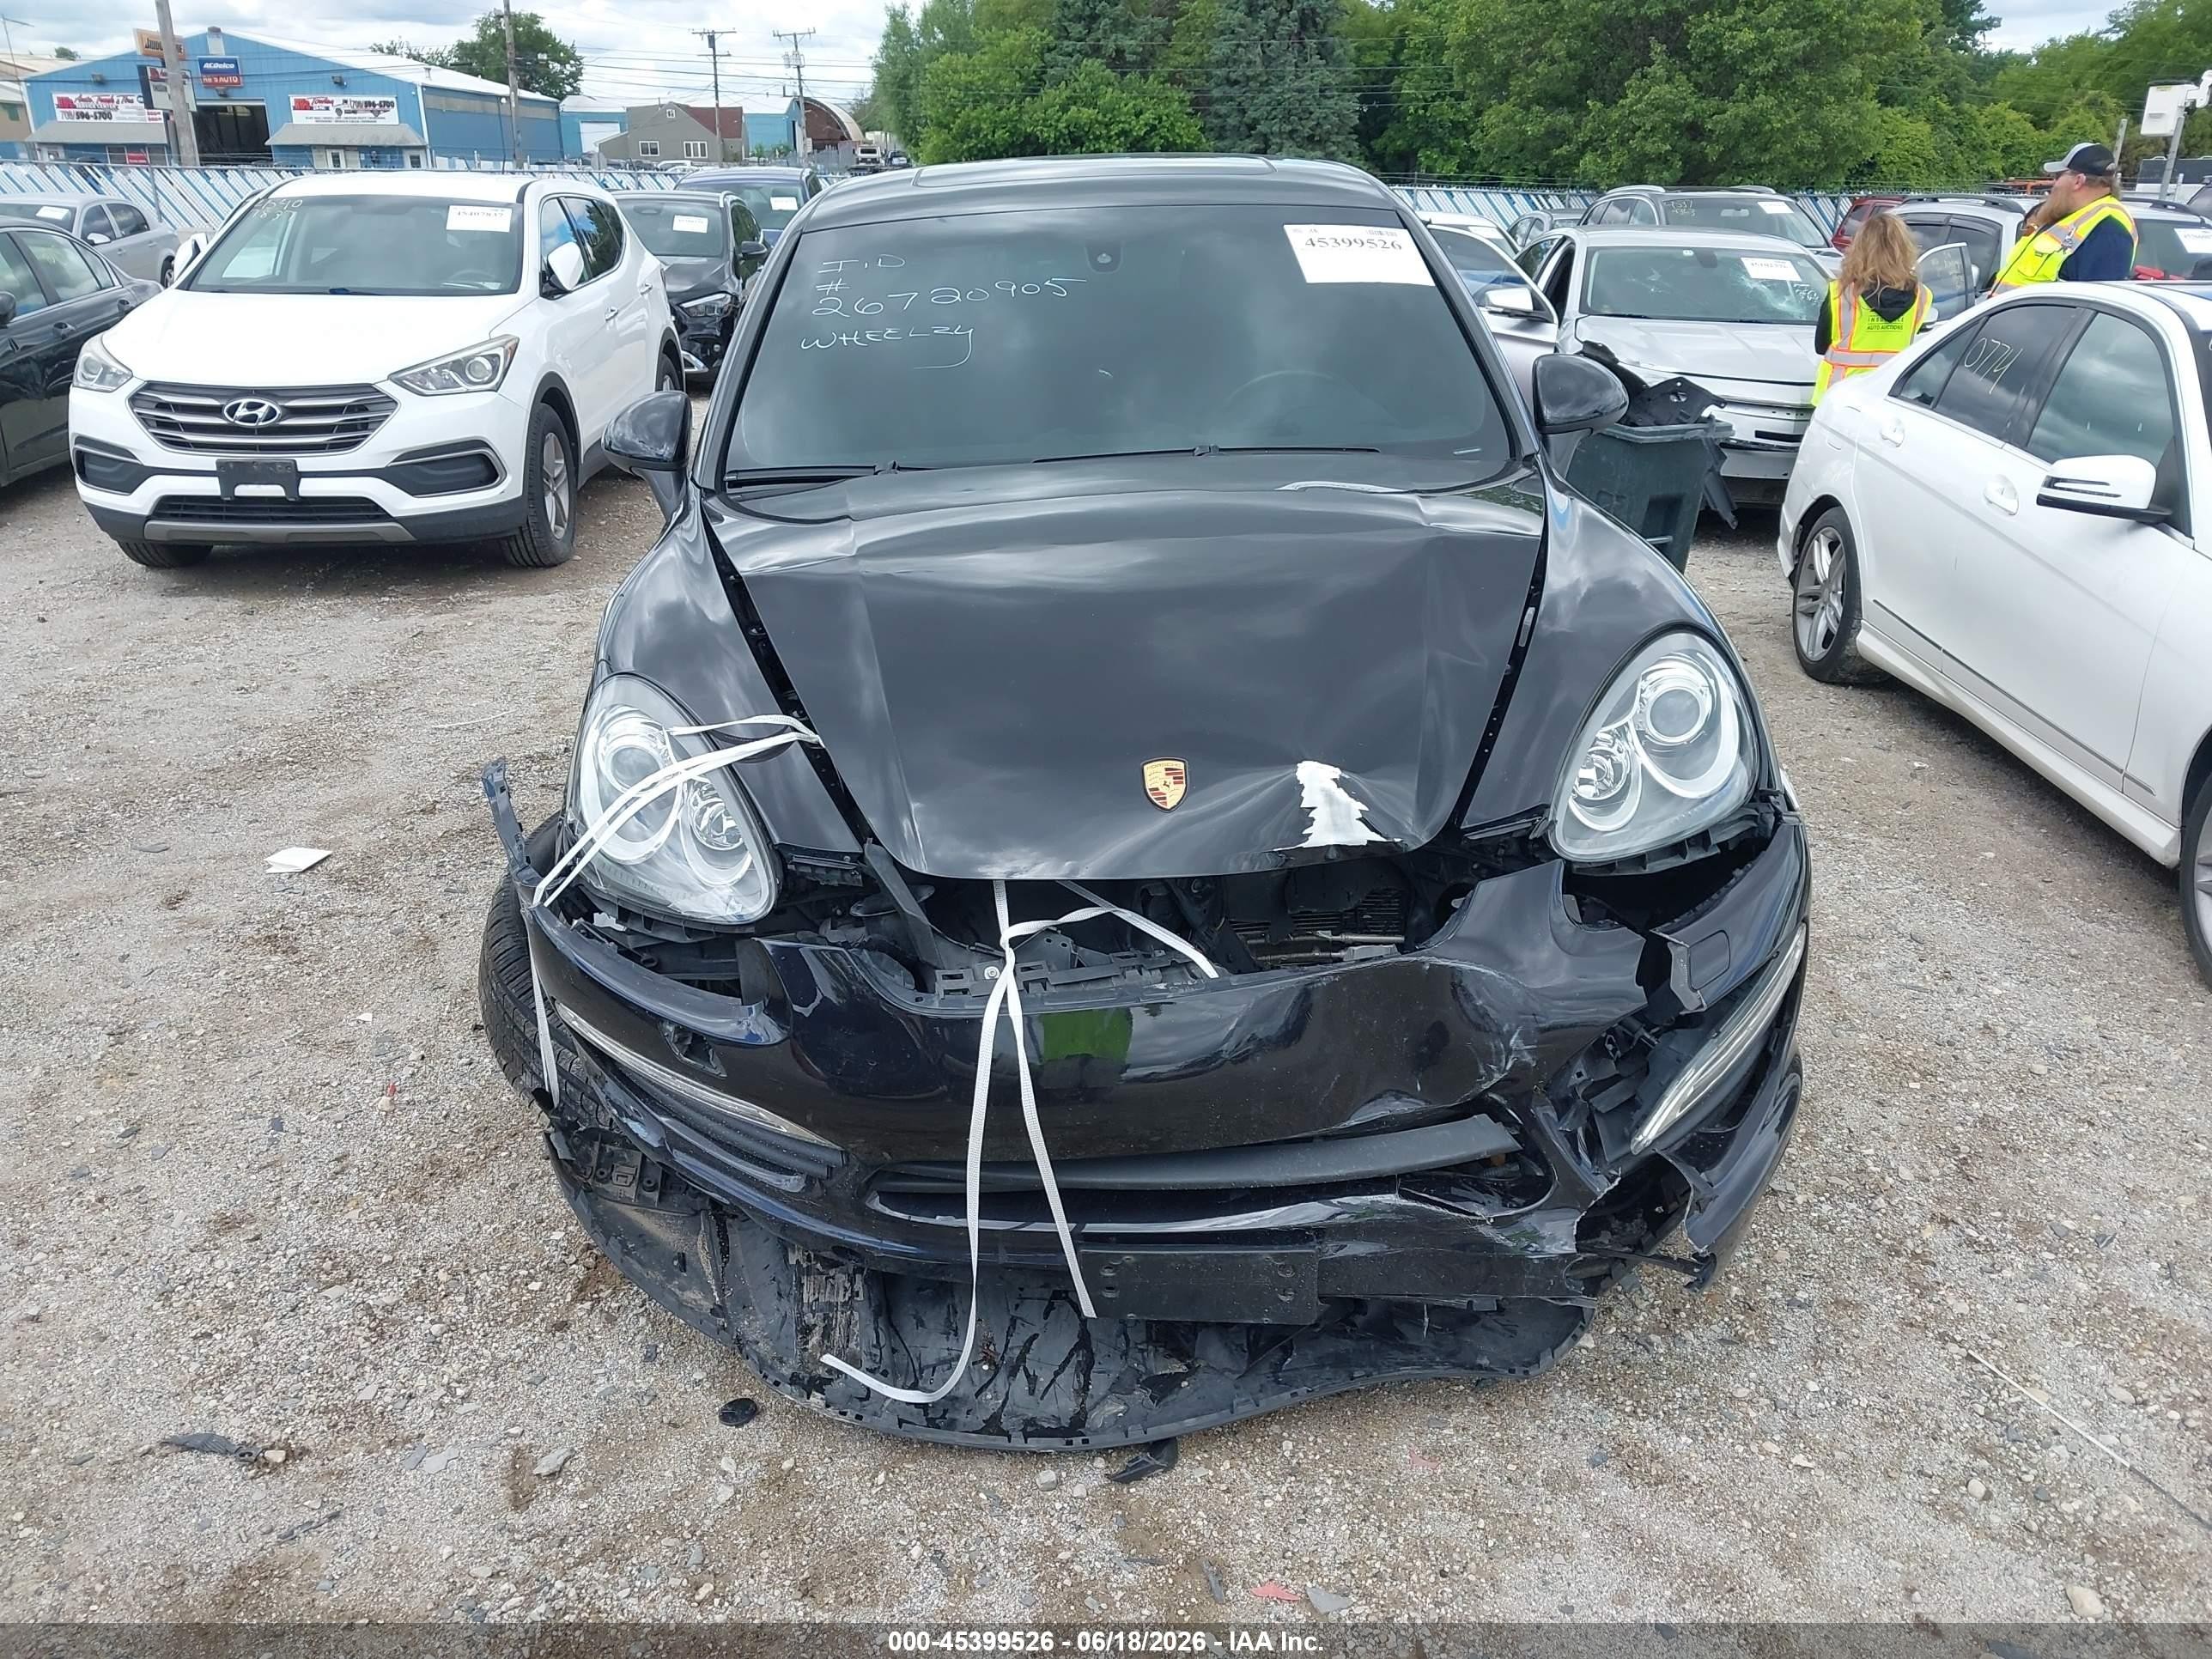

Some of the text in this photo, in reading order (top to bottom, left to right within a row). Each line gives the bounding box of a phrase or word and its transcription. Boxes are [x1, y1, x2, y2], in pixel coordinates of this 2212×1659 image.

[1304, 237, 1403, 251] 45399526
[811, 278, 1087, 318] 26720905
[816, 278, 850, 295] #
[1965, 337, 2023, 395] 0774
